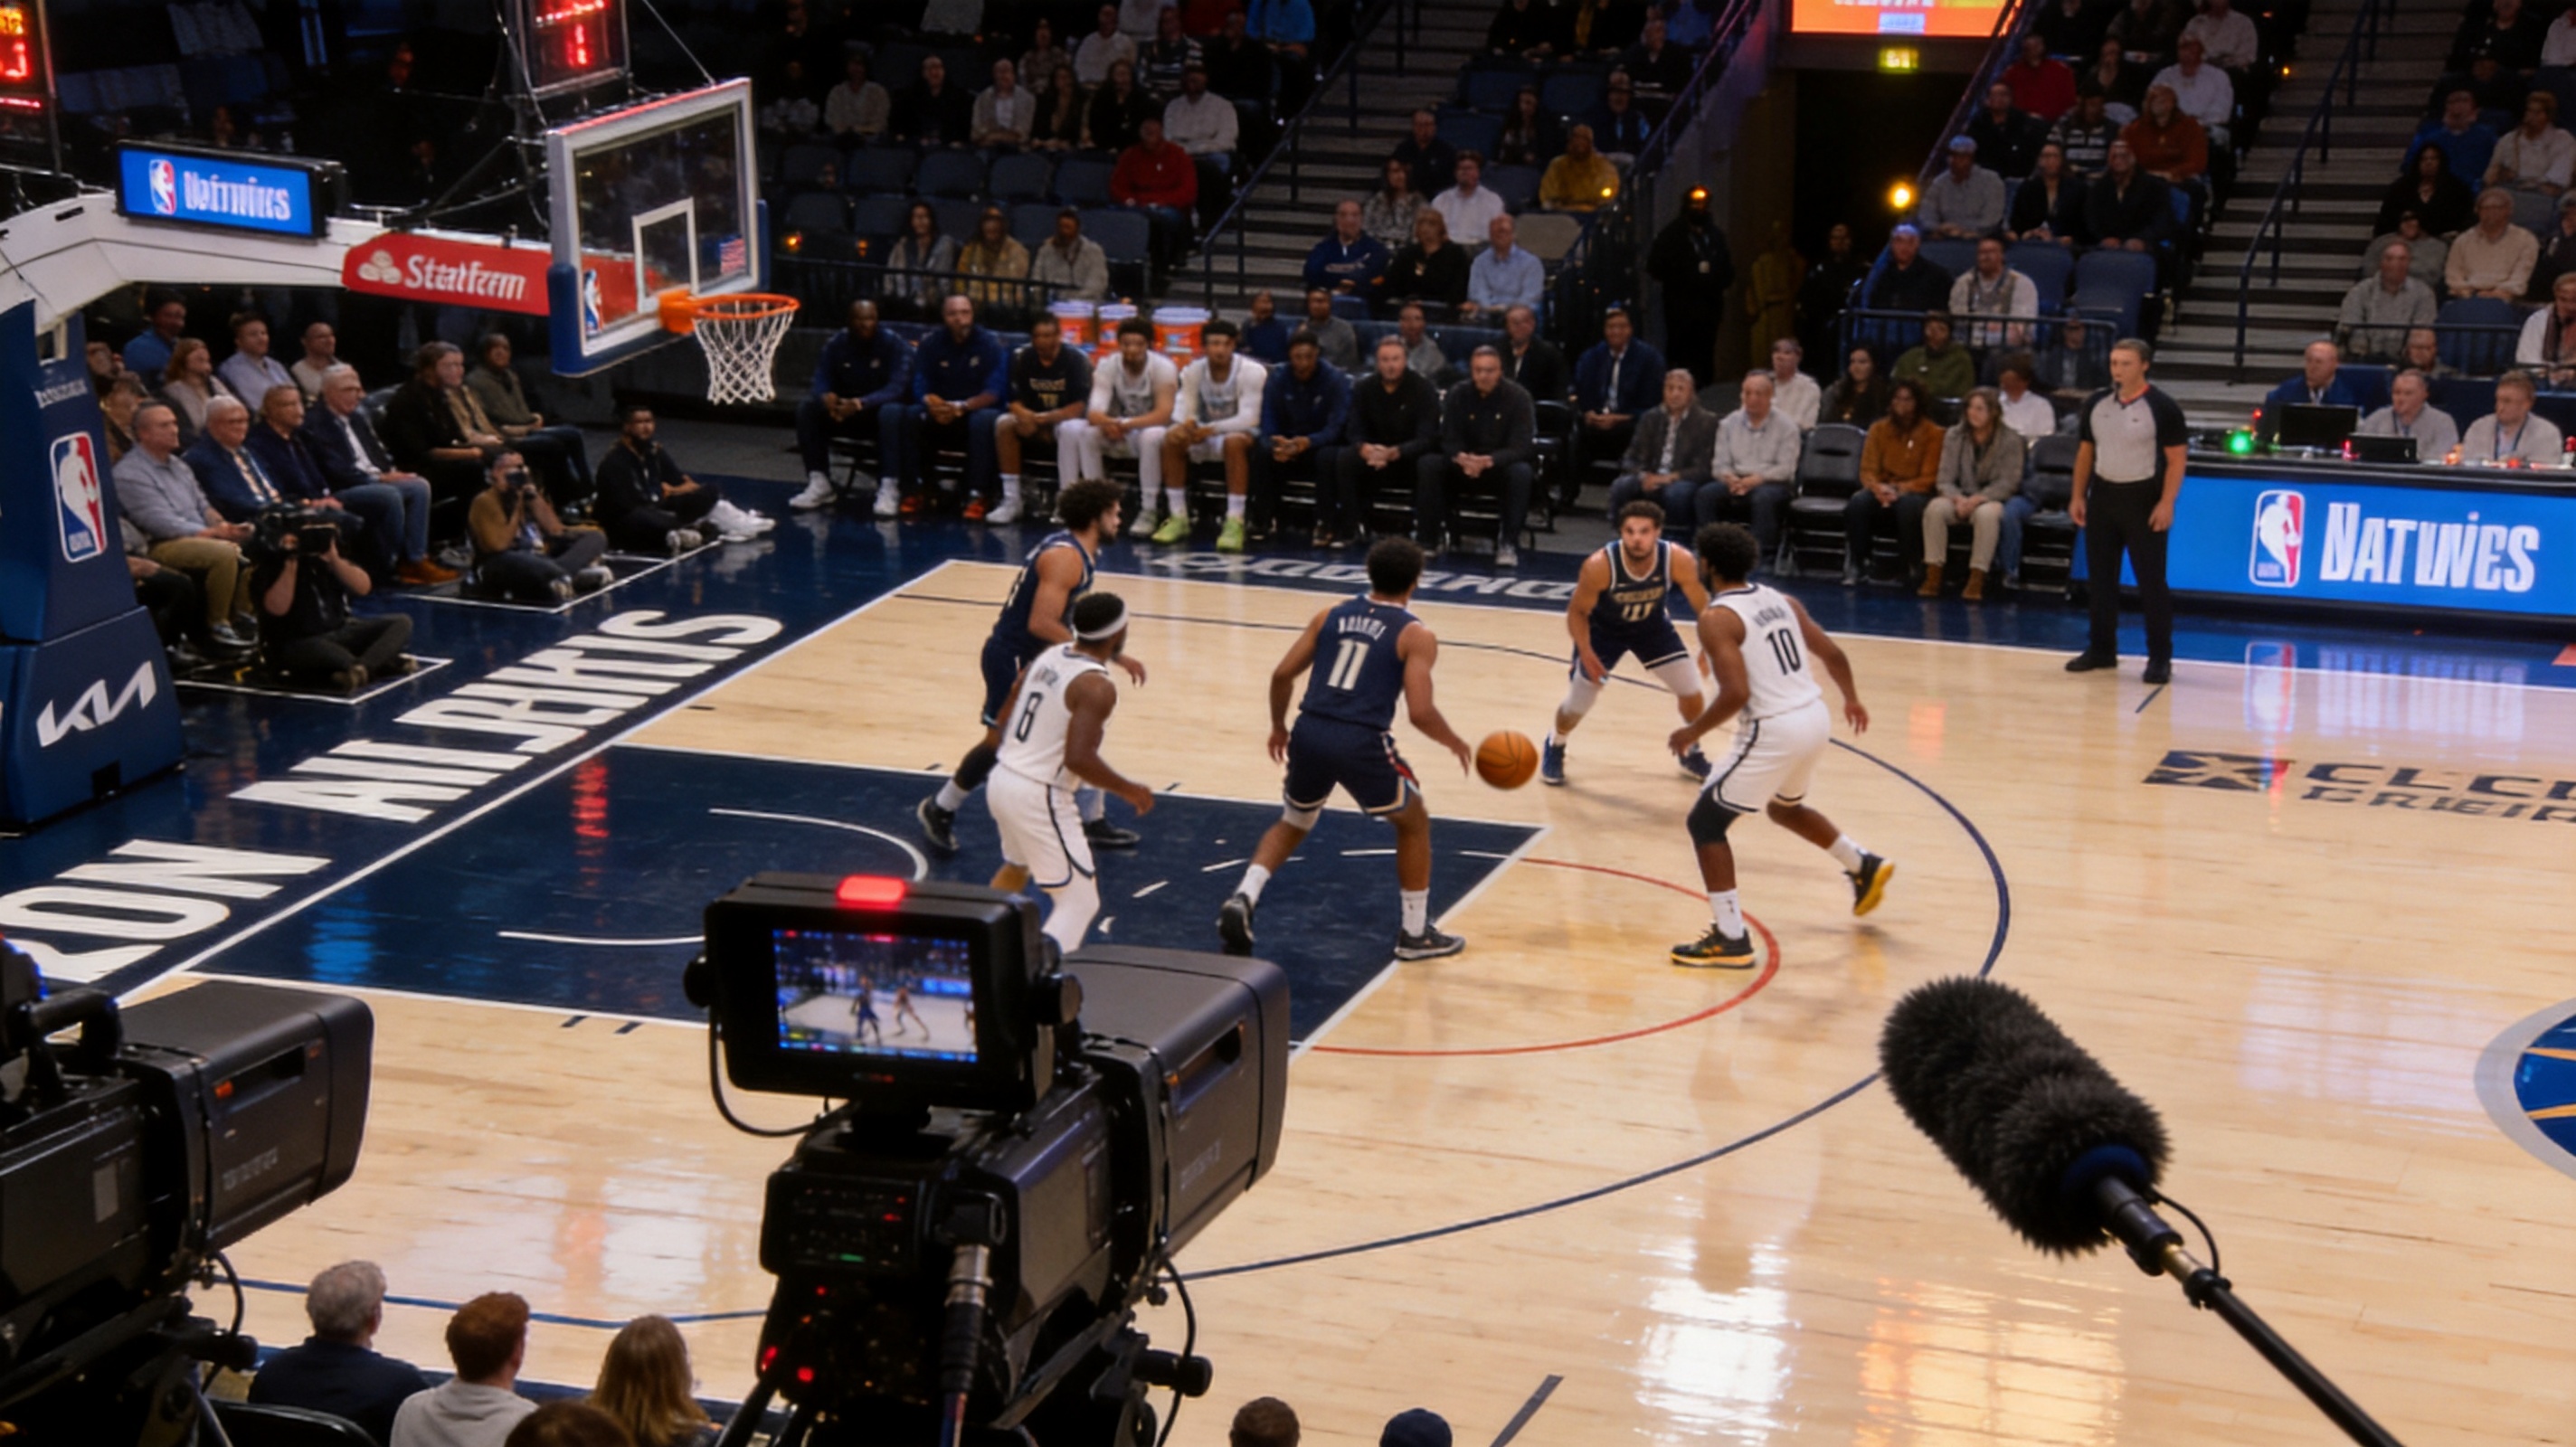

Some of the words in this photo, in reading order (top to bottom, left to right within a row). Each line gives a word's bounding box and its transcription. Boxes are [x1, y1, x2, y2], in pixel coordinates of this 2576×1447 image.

[1327, 638, 1369, 690] 11
[1766, 628, 1802, 676] 10
[1015, 691, 1044, 742] 8
